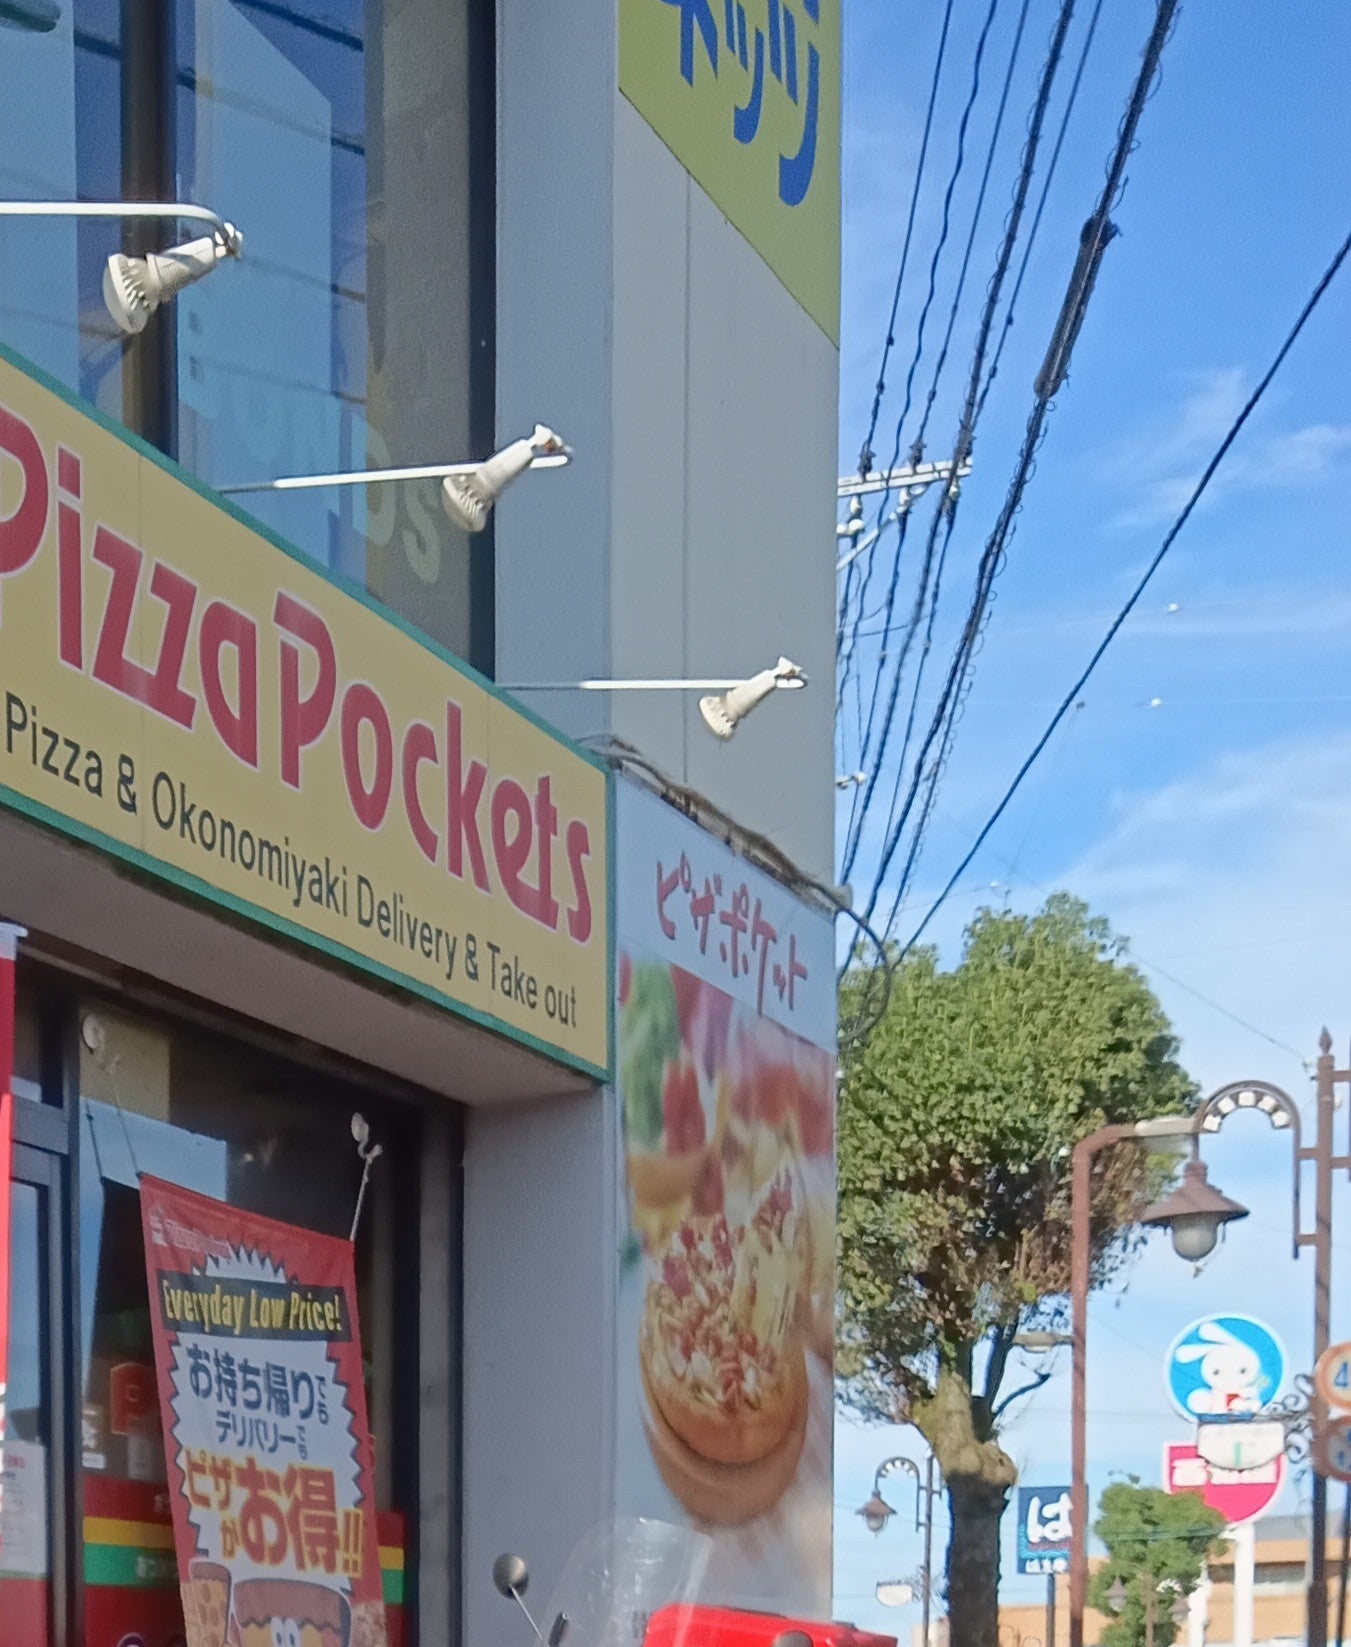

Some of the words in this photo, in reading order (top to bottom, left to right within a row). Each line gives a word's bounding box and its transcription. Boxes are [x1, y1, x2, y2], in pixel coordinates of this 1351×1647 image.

[5, 689, 103, 799] Pizza
[116, 753, 138, 816] &
[151, 771, 348, 918] Okonomiyaki
[356, 873, 457, 982] Delivery
[464, 932, 479, 982] &
[486, 940, 538, 1010] Take
[544, 984, 577, 1030] out
[249, 1288, 287, 1329] Low
[289, 1291, 343, 1332] Price!
